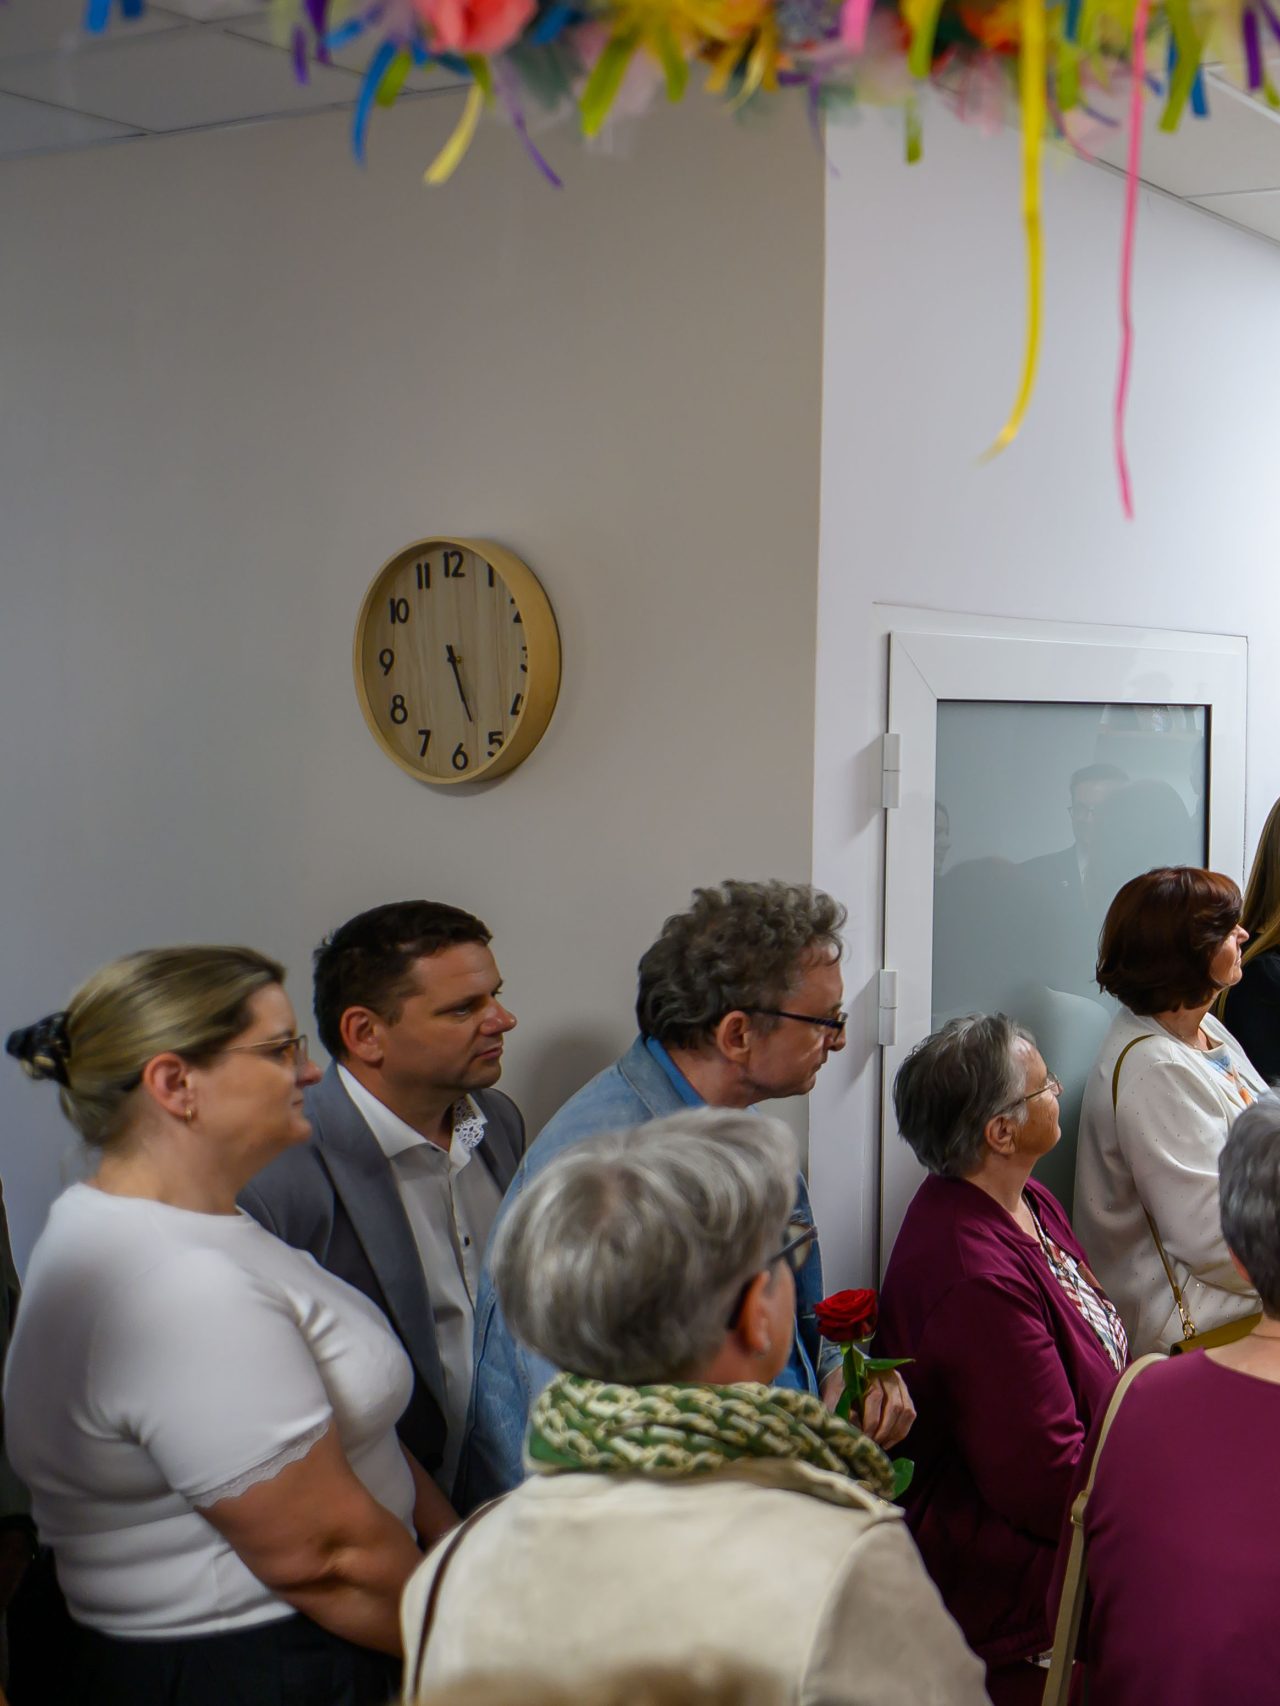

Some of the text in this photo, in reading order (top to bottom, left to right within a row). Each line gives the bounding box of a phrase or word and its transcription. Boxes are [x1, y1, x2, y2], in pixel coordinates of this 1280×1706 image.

[416, 562, 431, 589] 11
[443, 550, 466, 578] 12
[487, 563, 495, 588] 1
[390, 599, 410, 624] 10
[379, 648, 395, 676] 9
[390, 695, 408, 724] 8
[418, 730, 432, 757] 7
[452, 743, 468, 770] 6
[487, 731, 504, 758] 5
